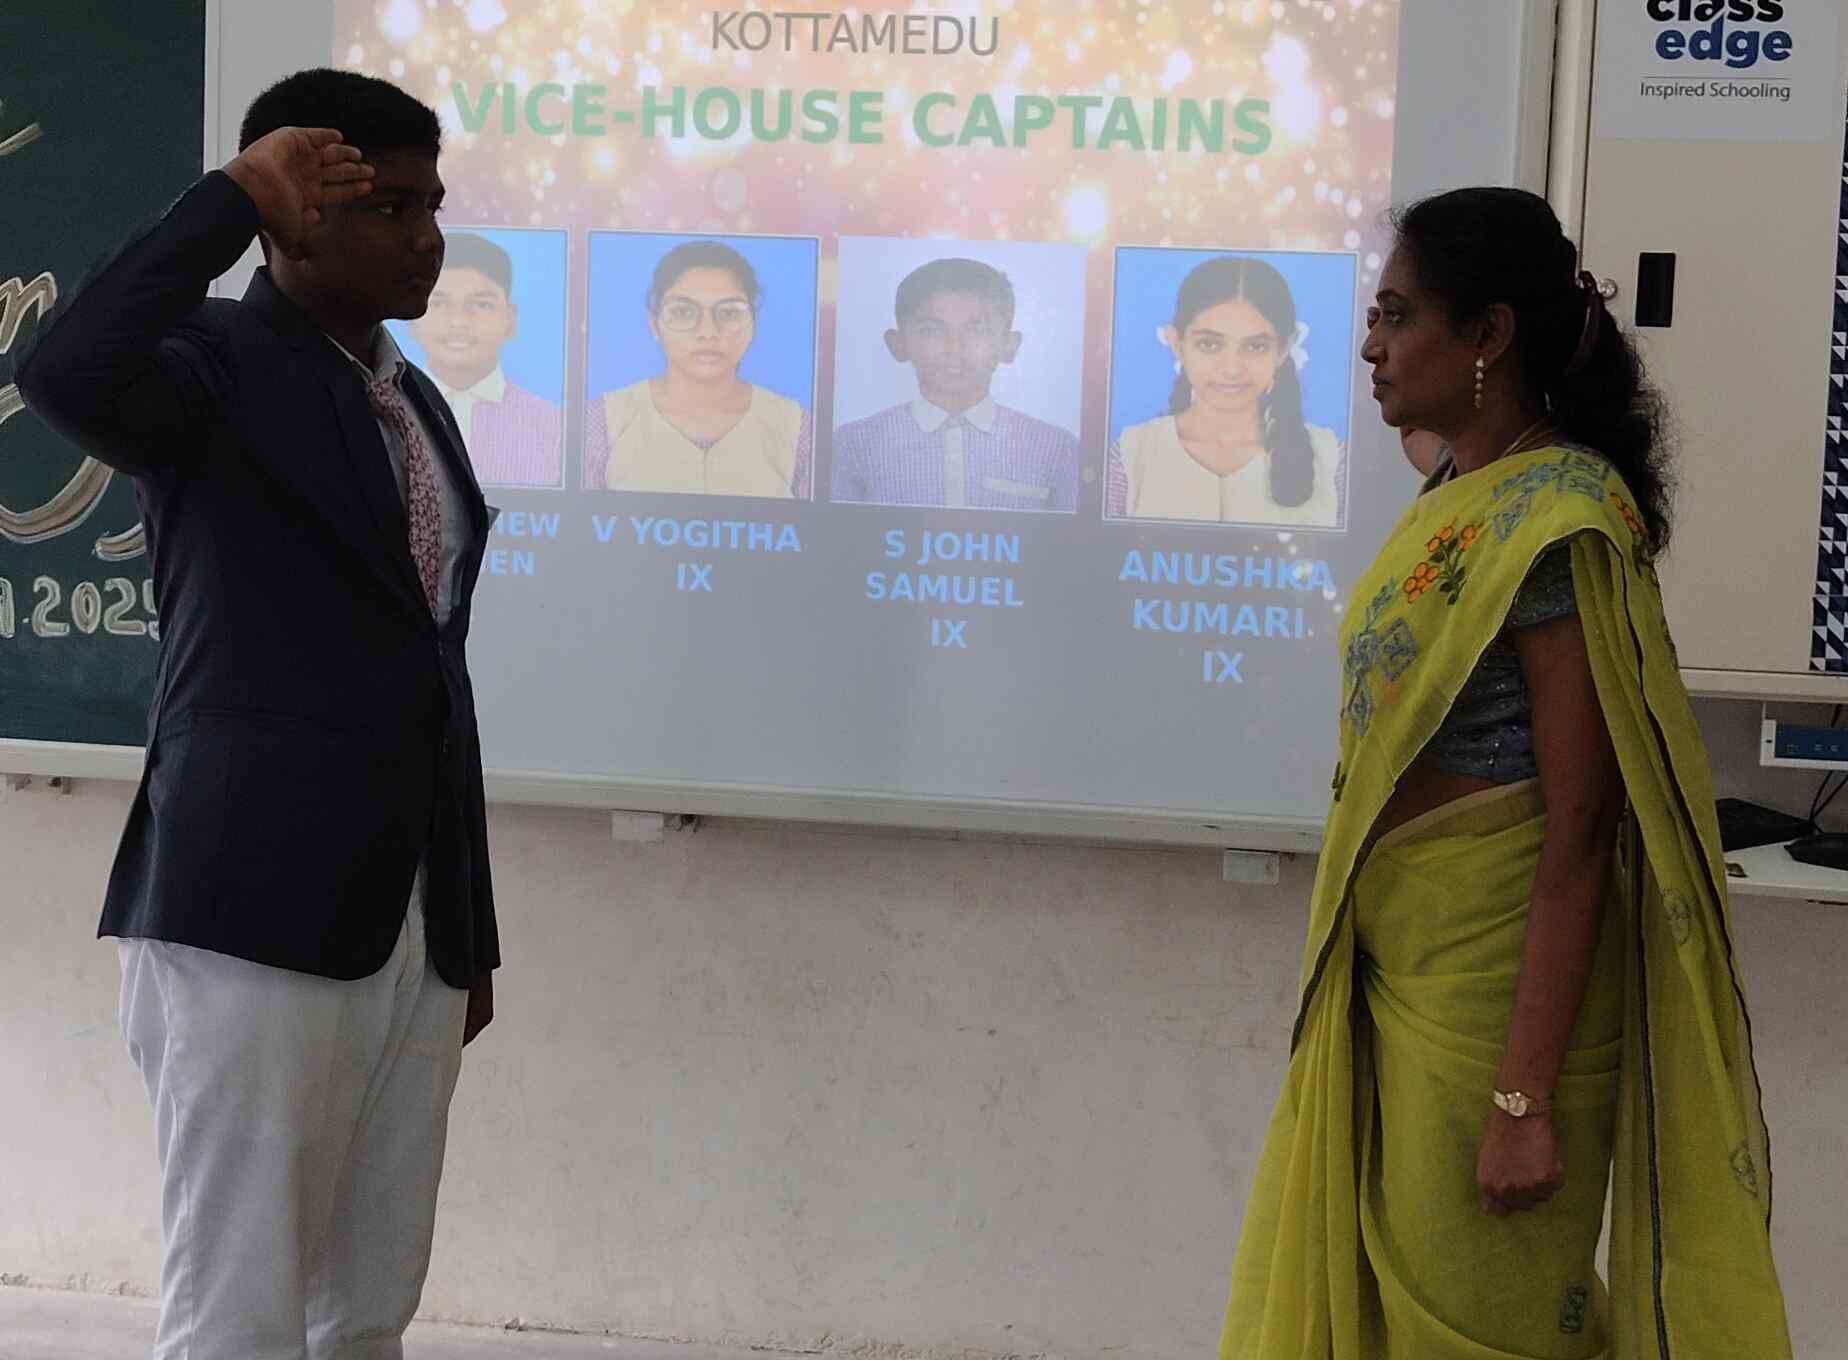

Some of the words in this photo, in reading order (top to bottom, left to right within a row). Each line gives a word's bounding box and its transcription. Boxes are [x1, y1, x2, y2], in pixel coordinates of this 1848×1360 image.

[712, 11, 1000, 57] KOTTAMEDU
[1655, 14, 1793, 69] edge
[1640, 82, 1705, 99] Inspired
[1710, 82, 1791, 102] Schooling
[450, 81, 885, 145] VICE-HOUSE
[912, 92, 1273, 155] CAPTAINS
[592, 515, 616, 543] V
[631, 516, 802, 553] YOGITHA
[884, 529, 905, 558] S
[917, 532, 1022, 565] JOHN
[677, 563, 713, 591] IX
[1119, 549, 1337, 592] ANUSHKA
[865, 572, 1024, 607] SAMUEL
[931, 619, 968, 648] IX
[1133, 598, 1306, 640] KUMARI
[1203, 650, 1245, 684] IX
